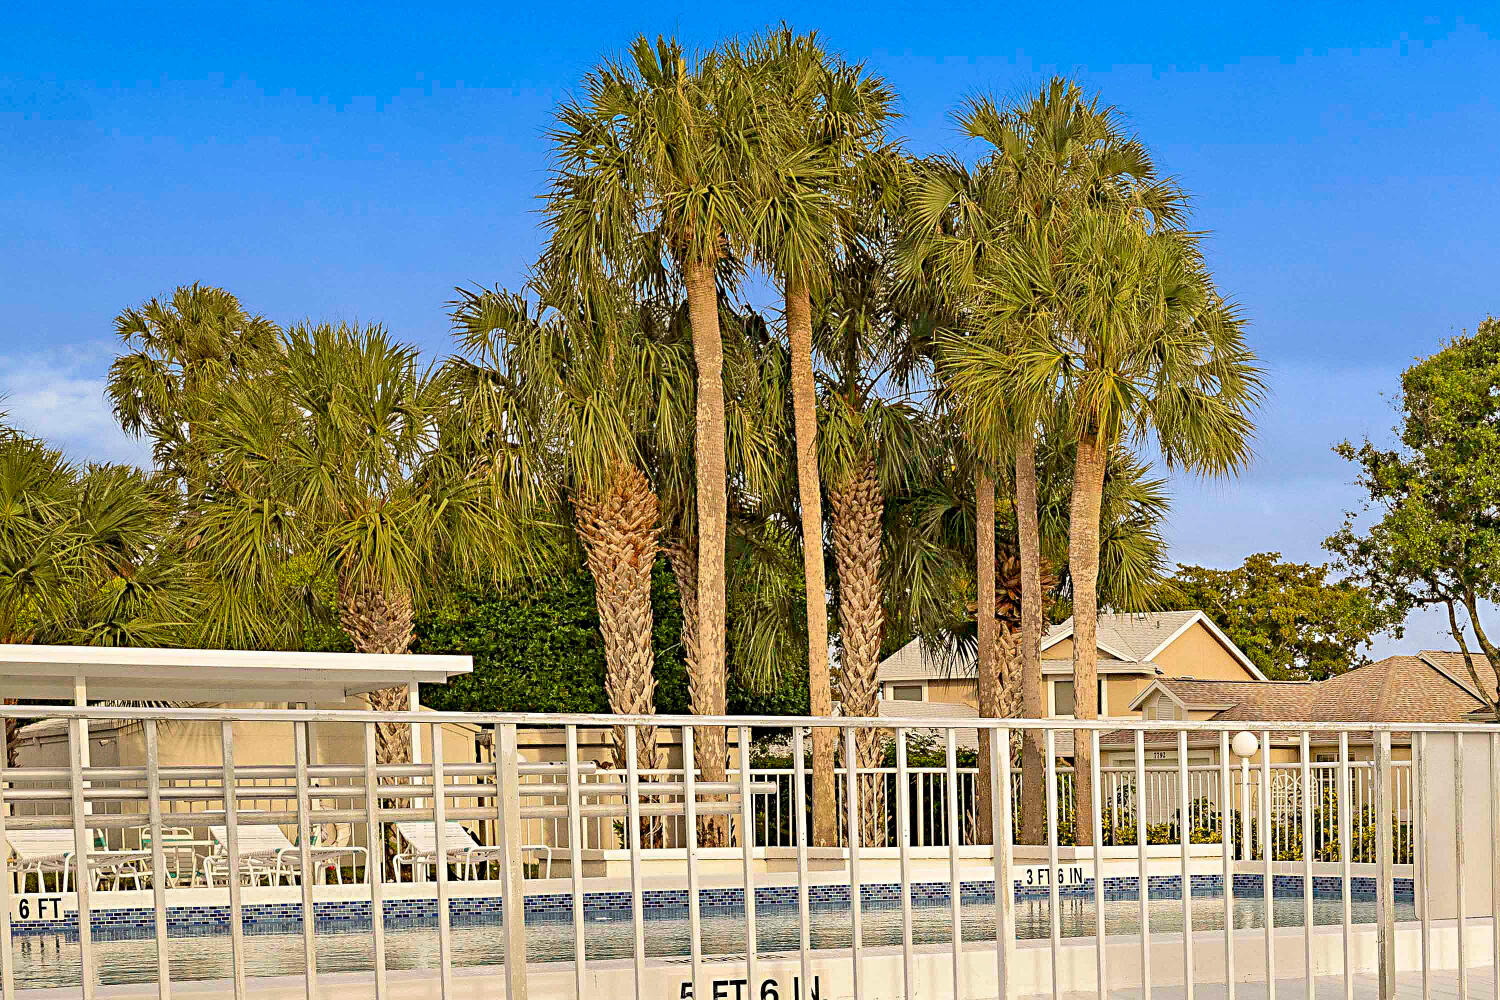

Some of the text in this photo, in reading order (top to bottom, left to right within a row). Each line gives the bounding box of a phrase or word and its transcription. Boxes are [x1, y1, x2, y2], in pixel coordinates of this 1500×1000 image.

[1026, 867, 1083, 885] 3 FT 6 IN
[19, 897, 62, 919] 6 FT
